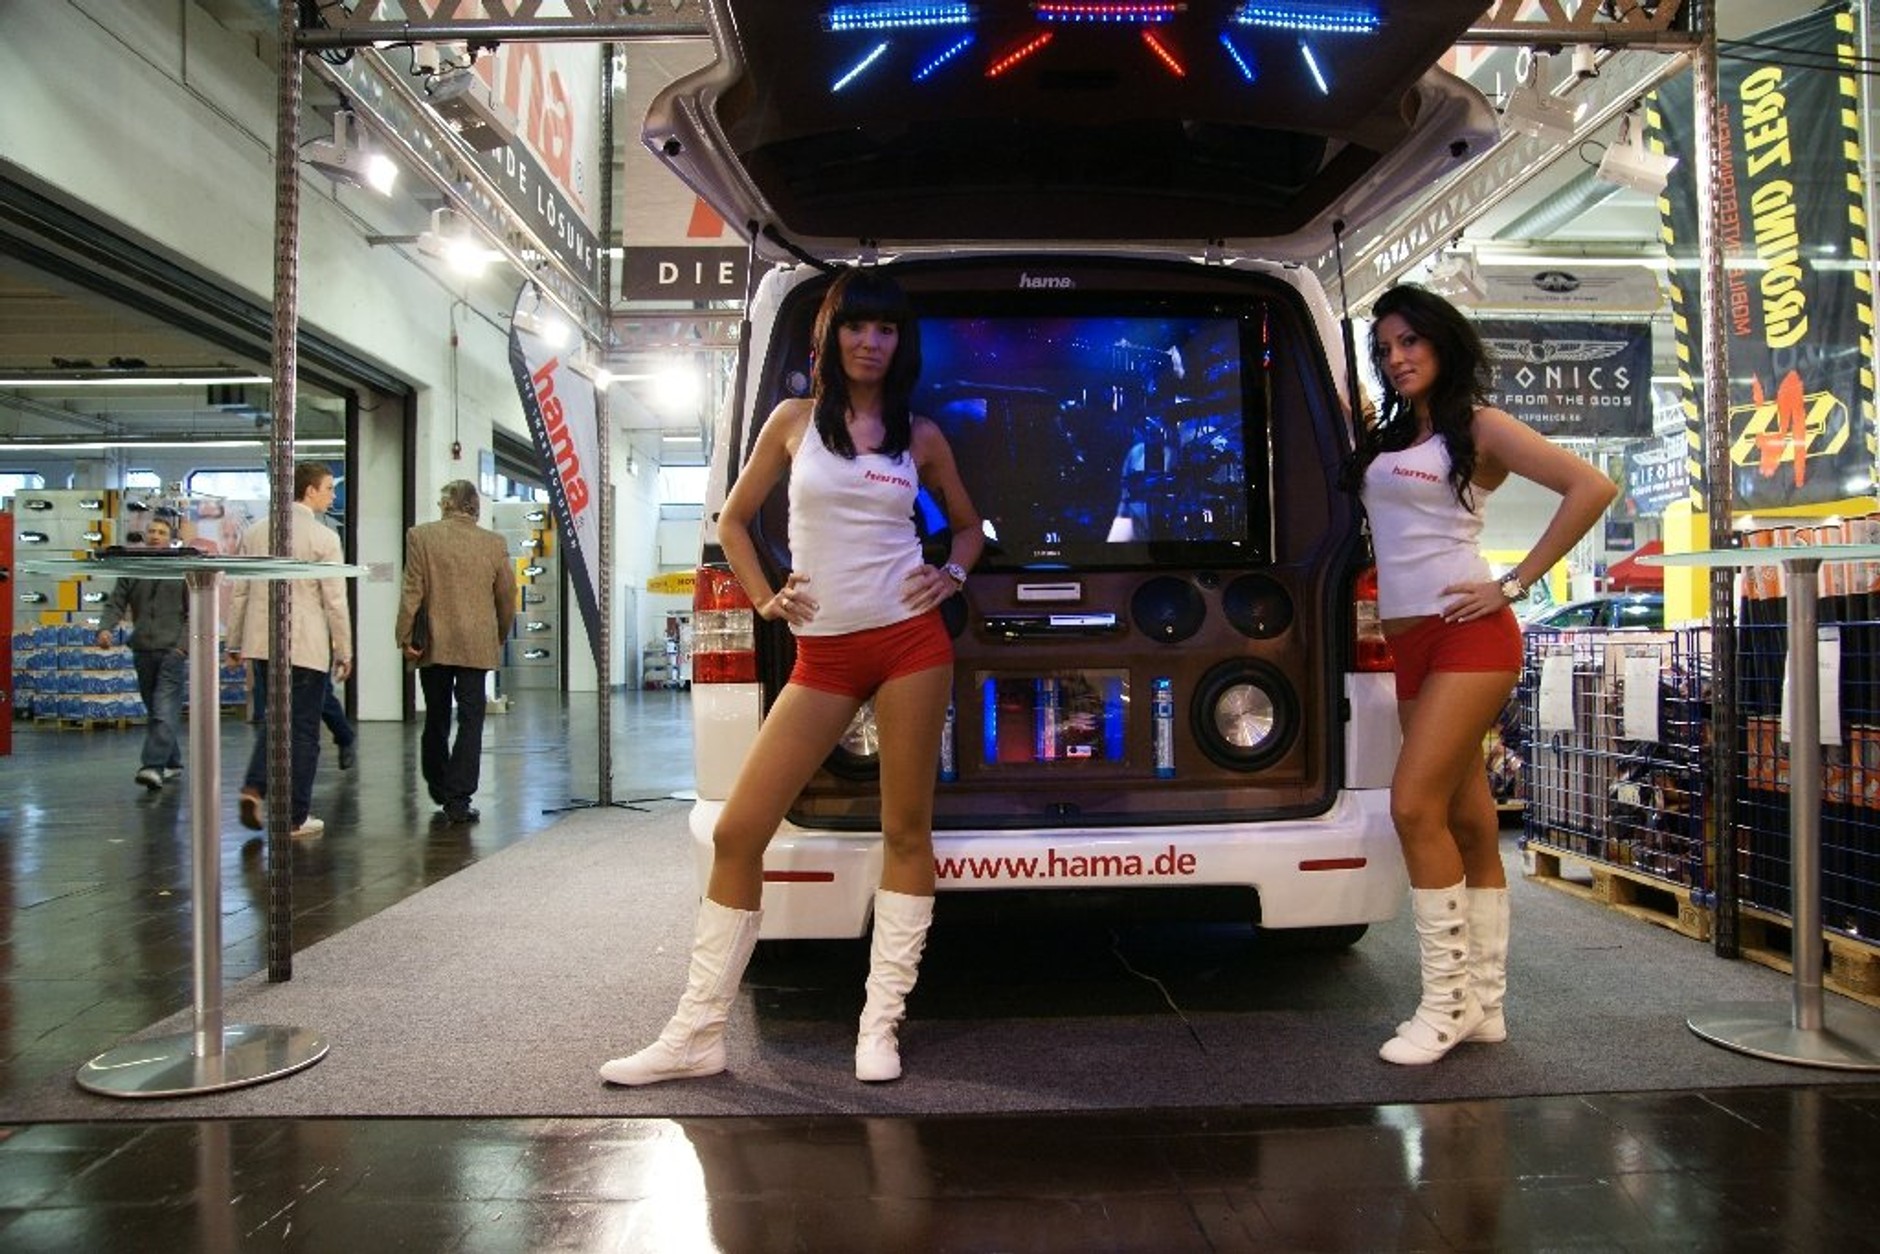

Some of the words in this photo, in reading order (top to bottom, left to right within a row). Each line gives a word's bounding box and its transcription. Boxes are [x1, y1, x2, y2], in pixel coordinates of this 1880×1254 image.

[658, 261, 734, 285] DIE
[1018, 271, 1071, 288] hama
[1492, 364, 1631, 391] FONICS
[1505, 393, 1549, 406] FROM
[1555, 394, 1584, 407] THE
[1589, 395, 1632, 407] GODS
[532, 355, 589, 515] hama
[933, 844, 1197, 879] www.hama.de
